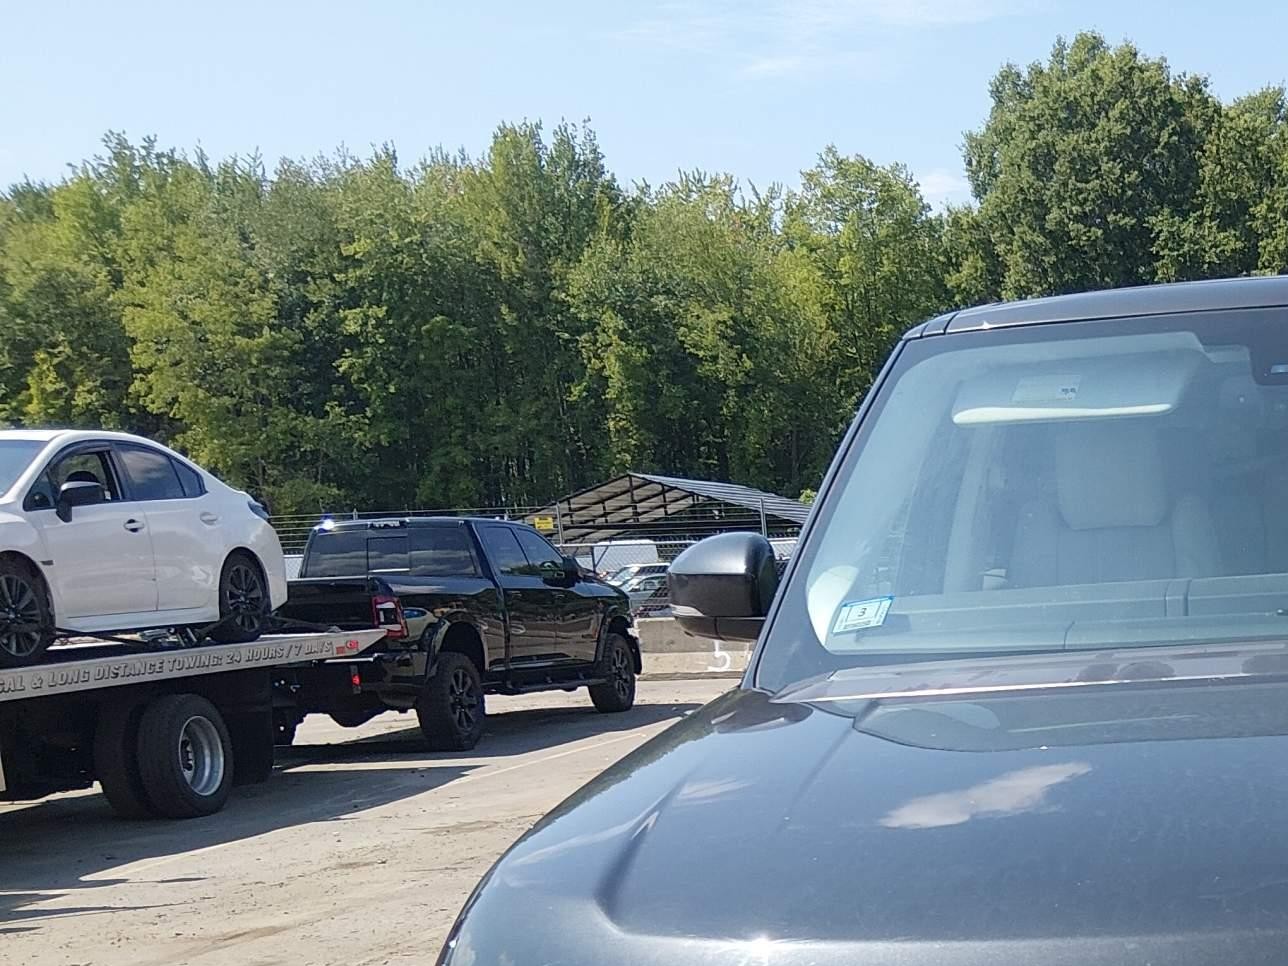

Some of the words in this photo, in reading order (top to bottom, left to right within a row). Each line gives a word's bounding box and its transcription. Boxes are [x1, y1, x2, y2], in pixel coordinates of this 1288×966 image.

[32, 676, 43, 689] &
[48, 670, 90, 687] LONG
[94, 659, 164, 681] DISTANCE
[168, 653, 222, 671] TOWING:
[226, 651, 242, 664] 24
[246, 647, 284, 662] HOURS
